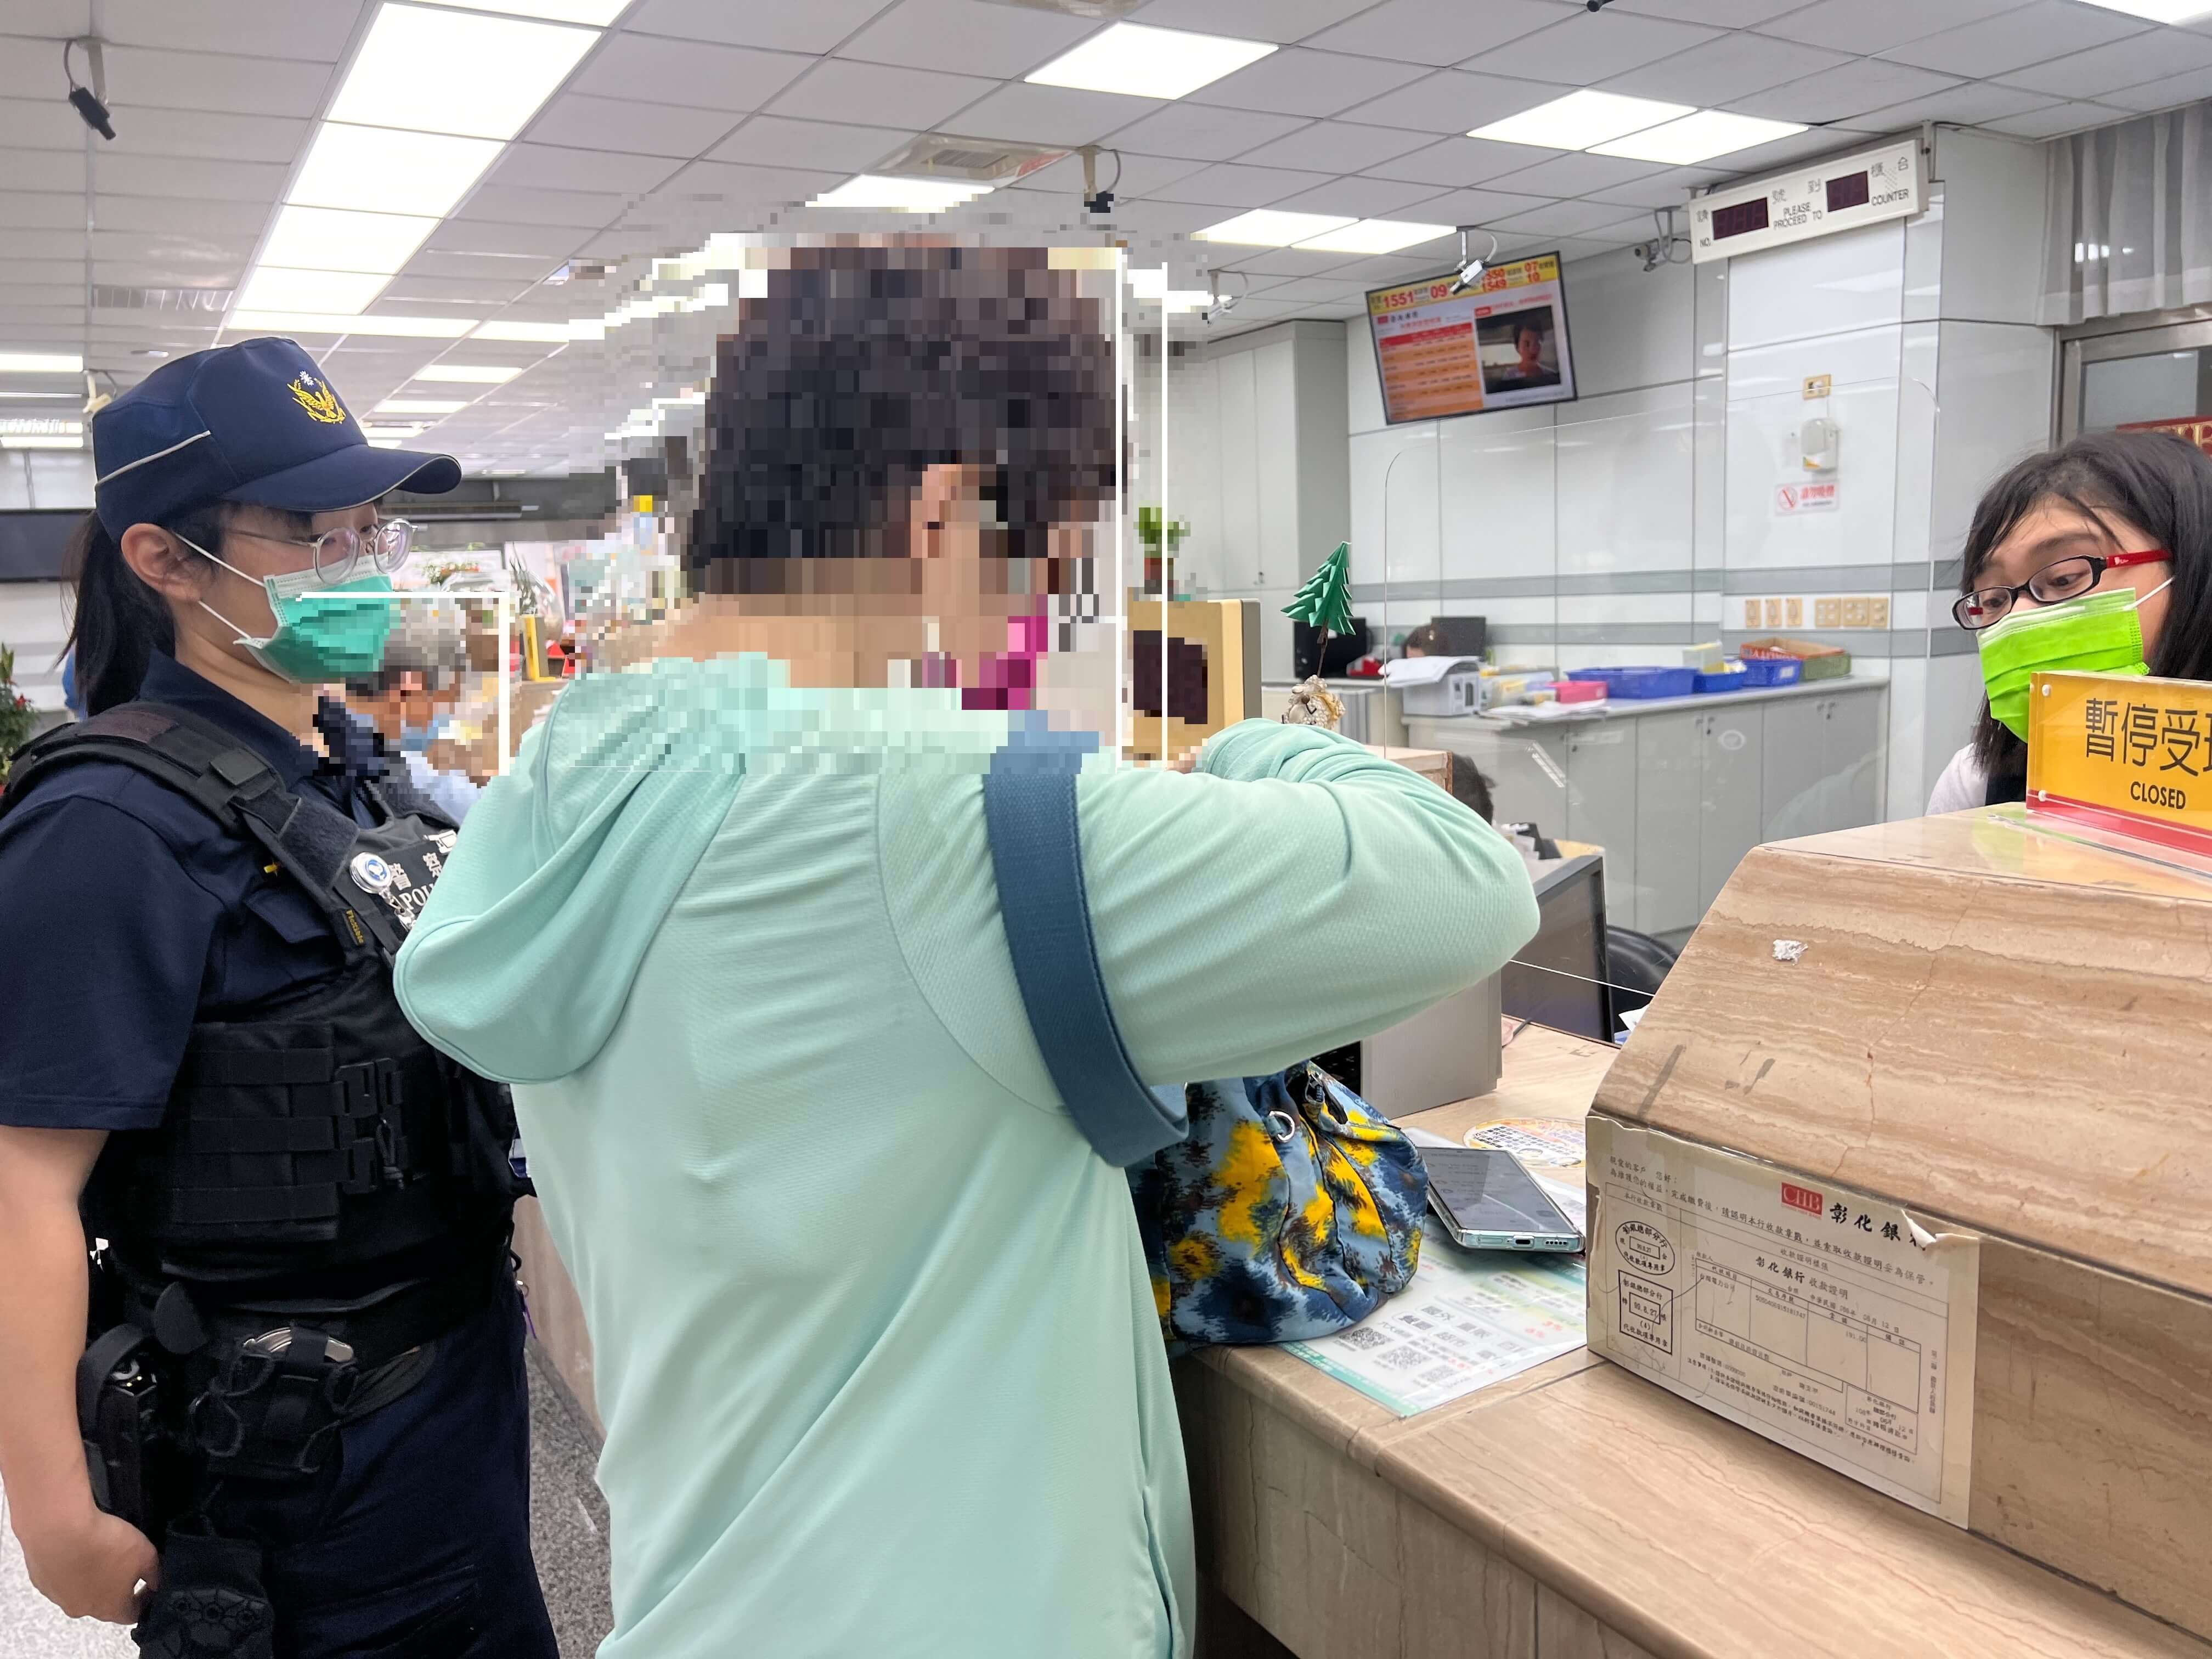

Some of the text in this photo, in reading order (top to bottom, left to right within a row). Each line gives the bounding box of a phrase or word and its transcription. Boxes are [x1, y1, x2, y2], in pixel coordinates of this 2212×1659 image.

[1783, 202, 1811, 216] PLEASE
[1871, 188, 1909, 206] COUNTER
[1773, 210, 1823, 230] PROCEED TO
[1384, 291, 1414, 308] 1551
[1430, 284, 1449, 299] 09
[2085, 698, 2212, 777] 暫停受
[2130, 781, 2186, 810] CLOSED
[1783, 1186, 1820, 1211] CHB
